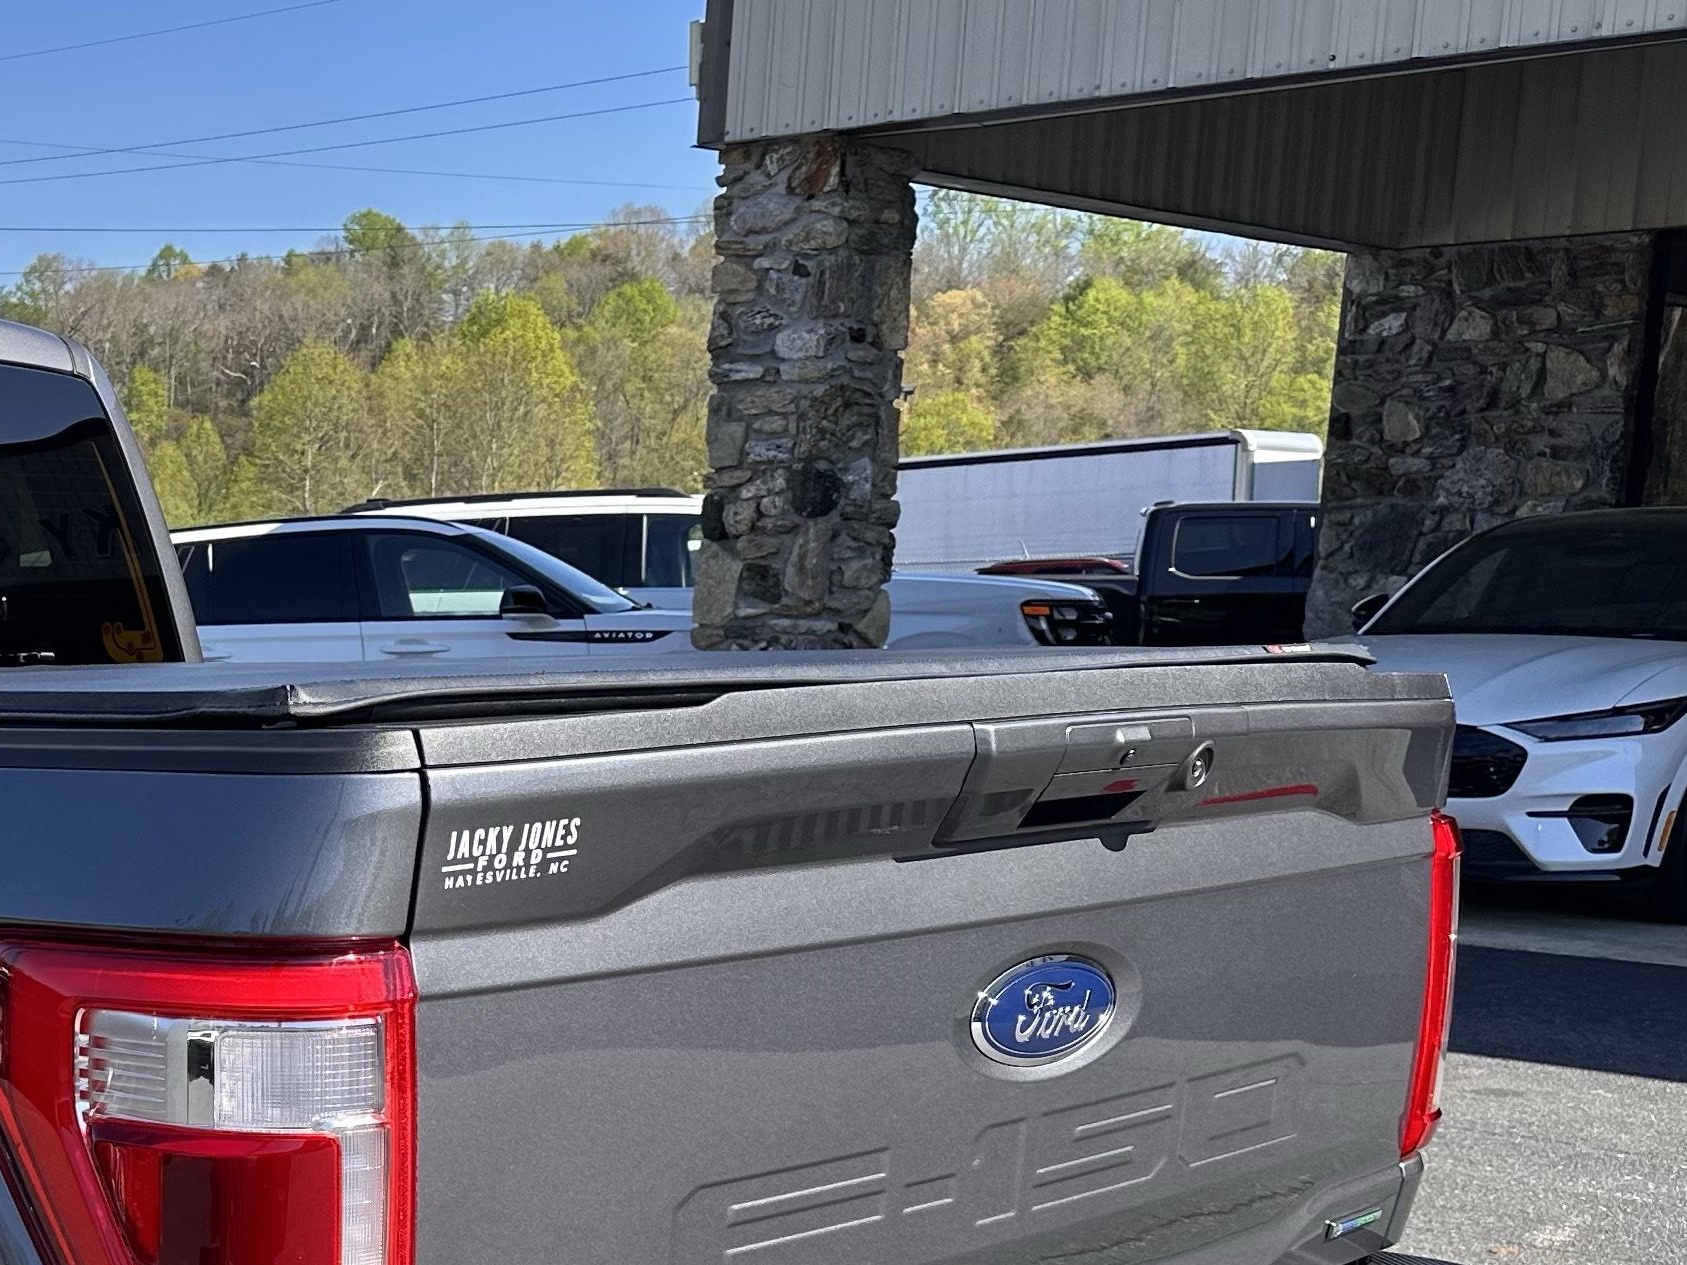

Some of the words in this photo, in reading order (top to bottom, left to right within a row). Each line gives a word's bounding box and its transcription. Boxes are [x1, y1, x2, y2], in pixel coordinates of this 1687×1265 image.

[446, 825, 514, 860] JACKY
[518, 817, 581, 851] JONES
[477, 849, 543, 872] FORD
[548, 860, 570, 875] NC
[1015, 980, 1091, 1042] Ford
